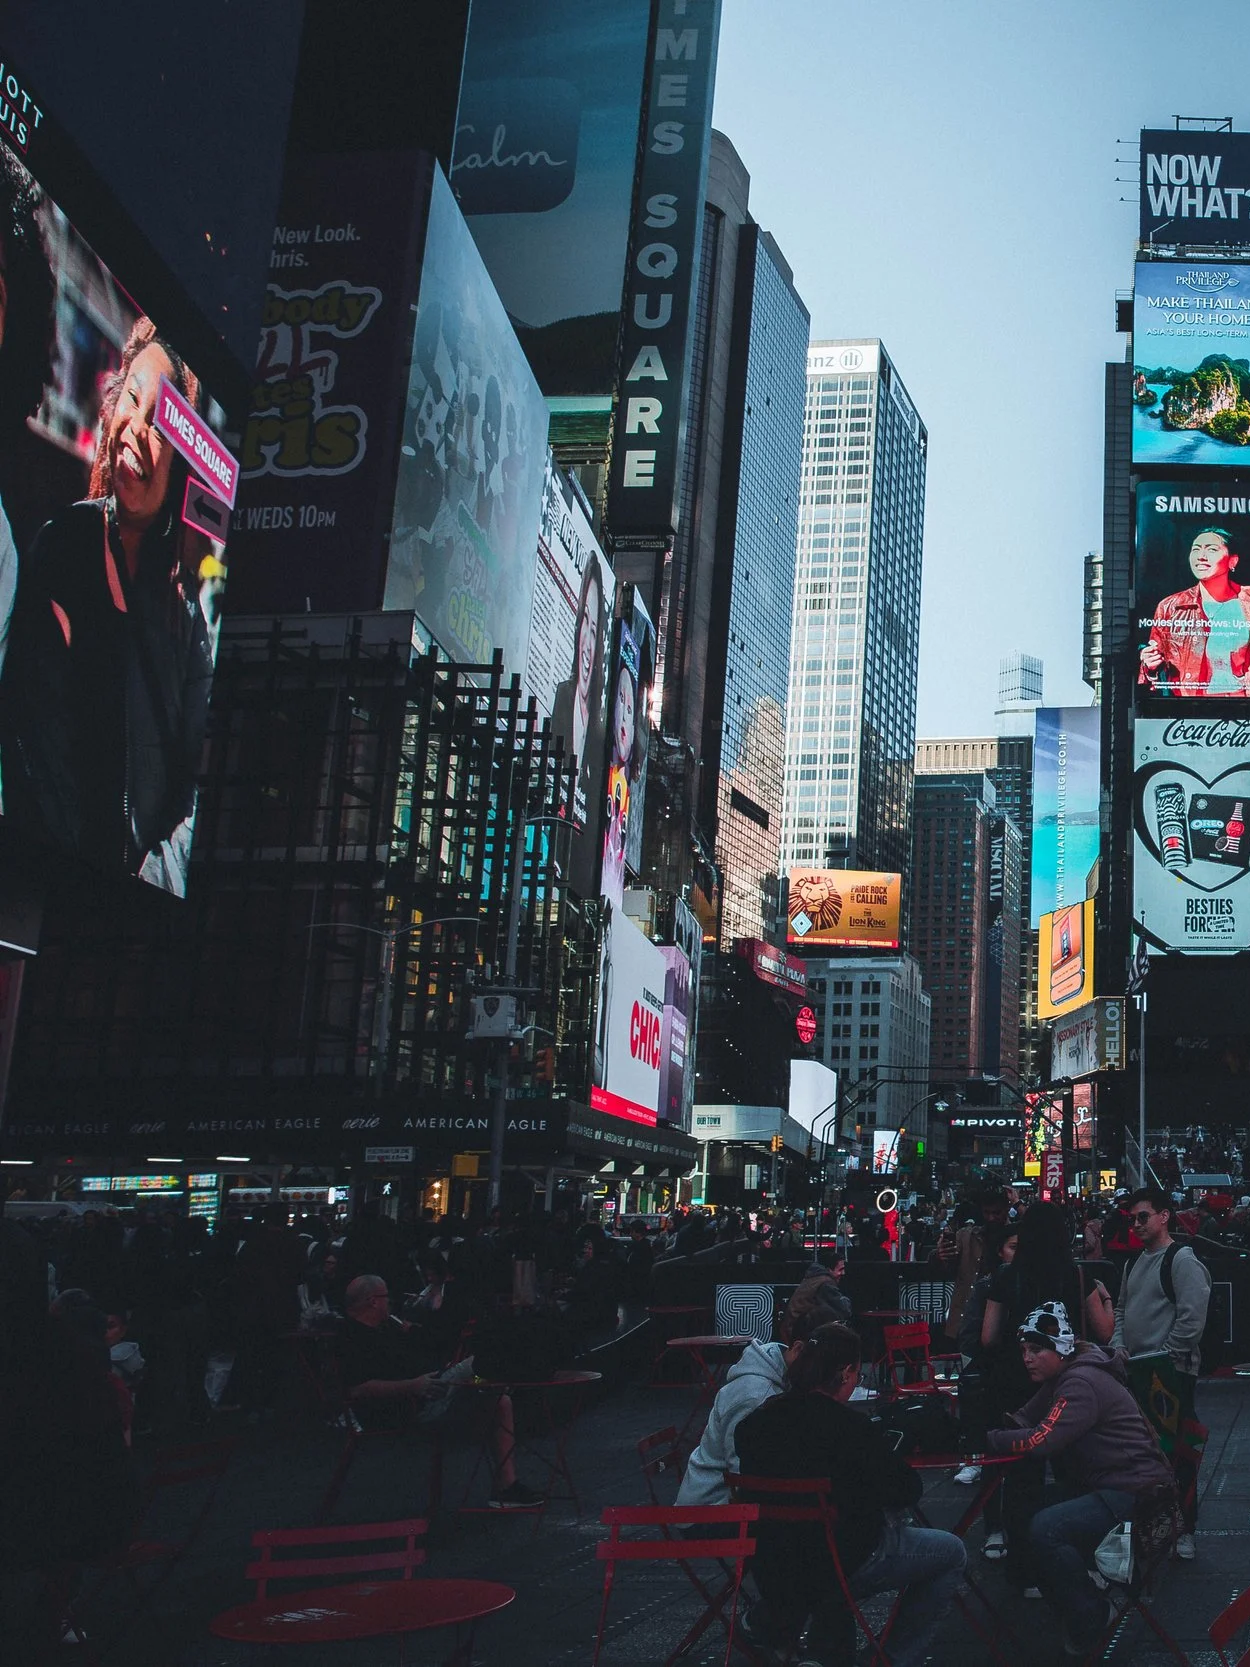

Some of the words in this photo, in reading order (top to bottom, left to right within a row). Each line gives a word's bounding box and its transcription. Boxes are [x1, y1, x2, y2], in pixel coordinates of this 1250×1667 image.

[1147, 154, 1222, 186] NOW
[273, 227, 311, 244] New
[314, 224, 360, 243] Look.
[1176, 276, 1225, 286] PRIVILEGE
[1187, 271, 1229, 279] THAILAND
[1147, 296, 1189, 308] MAKE
[1163, 312, 1205, 324] YOUR
[1147, 329, 1175, 337] ASIA'S
[1197, 330, 1248, 338] LONG-TERM
[621, 194, 679, 487] SQUARE
[164, 397, 195, 446] TIMES
[194, 434, 232, 489] SQUARE
[247, 507, 293, 529] WEDS
[1139, 618, 1171, 628] Movies
[1174, 618, 1193, 628] and
[1196, 619, 1230, 628] shows:
[1163, 719, 1250, 748] Coca-Cola
[1191, 820, 1224, 830] OREO
[851, 885, 869, 894] PRIDE
[871, 886, 888, 895] ROCK
[856, 893, 888, 905] CALLING
[1186, 899, 1233, 915] BESTIES
[850, 916, 866, 928] LION
[866, 916, 886, 928] KING
[1104, 1001, 1120, 1068] HELLO!
[187, 1118, 266, 1131] AMERICAN
[275, 1117, 321, 1129] EAGLE
[341, 1113, 381, 1130] aerie
[403, 1118, 489, 1130] AMERICAN
[697, 1116, 707, 1125] OUR
[1046, 1152, 1064, 1189] tkts
